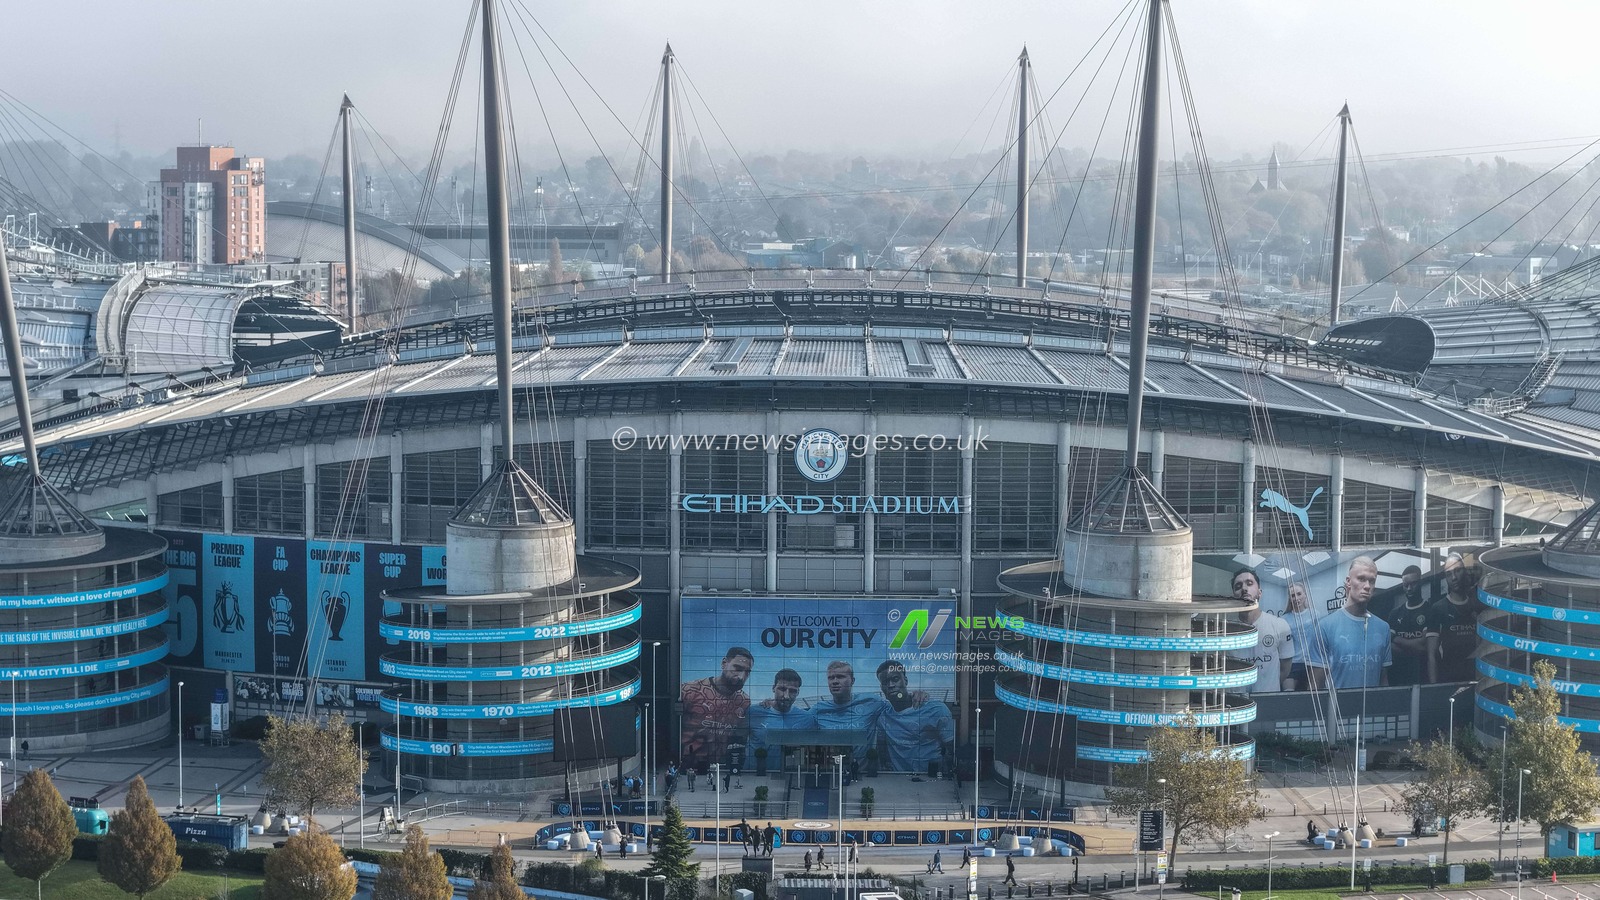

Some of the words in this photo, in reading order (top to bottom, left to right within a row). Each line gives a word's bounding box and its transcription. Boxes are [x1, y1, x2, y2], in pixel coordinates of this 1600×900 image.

[682, 493, 825, 514] ETIHAD
[832, 495, 960, 514] STADIUM
[210, 542, 244, 556] PREMIER
[276, 546, 286, 558] FA
[310, 548, 360, 562] CHAMPIONS
[180, 550, 196, 566] BIG
[214, 555, 241, 568] LEAGUE
[379, 552, 406, 566] SUPER
[272, 558, 288, 571] CUP
[320, 562, 350, 575] LEAGUE
[384, 566, 402, 578] CUP
[47, 596, 78, 604] without
[1486, 594, 1501, 607] CITY
[778, 616, 842, 626] WELCOME
[844, 616, 860, 627] TO
[5, 634, 15, 643] THE
[16, 634, 30, 642] FANS
[32, 633, 38, 642] OF
[40, 632, 50, 641] THE
[52, 630, 79, 640] INVISIBLE
[80, 628, 95, 638] MAN,
[96, 625, 112, 635] WE'RE
[113, 623, 122, 633] NOT
[123, 620, 137, 631] REALLY
[138, 618, 147, 628] HERE
[408, 630, 430, 640] 2019
[534, 626, 566, 638] 2022
[761, 628, 815, 648] OUR
[818, 628, 878, 648] CITY
[1514, 639, 1538, 651] CITY
[61, 666, 79, 674] TILL
[85, 664, 98, 672] DIE
[522, 666, 552, 677] 2012
[1552, 681, 1581, 693] CITY
[414, 706, 438, 716] 1968
[482, 706, 514, 716] 1970
[1125, 713, 1156, 724] OFFICIAL
[1202, 714, 1220, 724] CLUBS
[186, 827, 207, 836] Pizza
